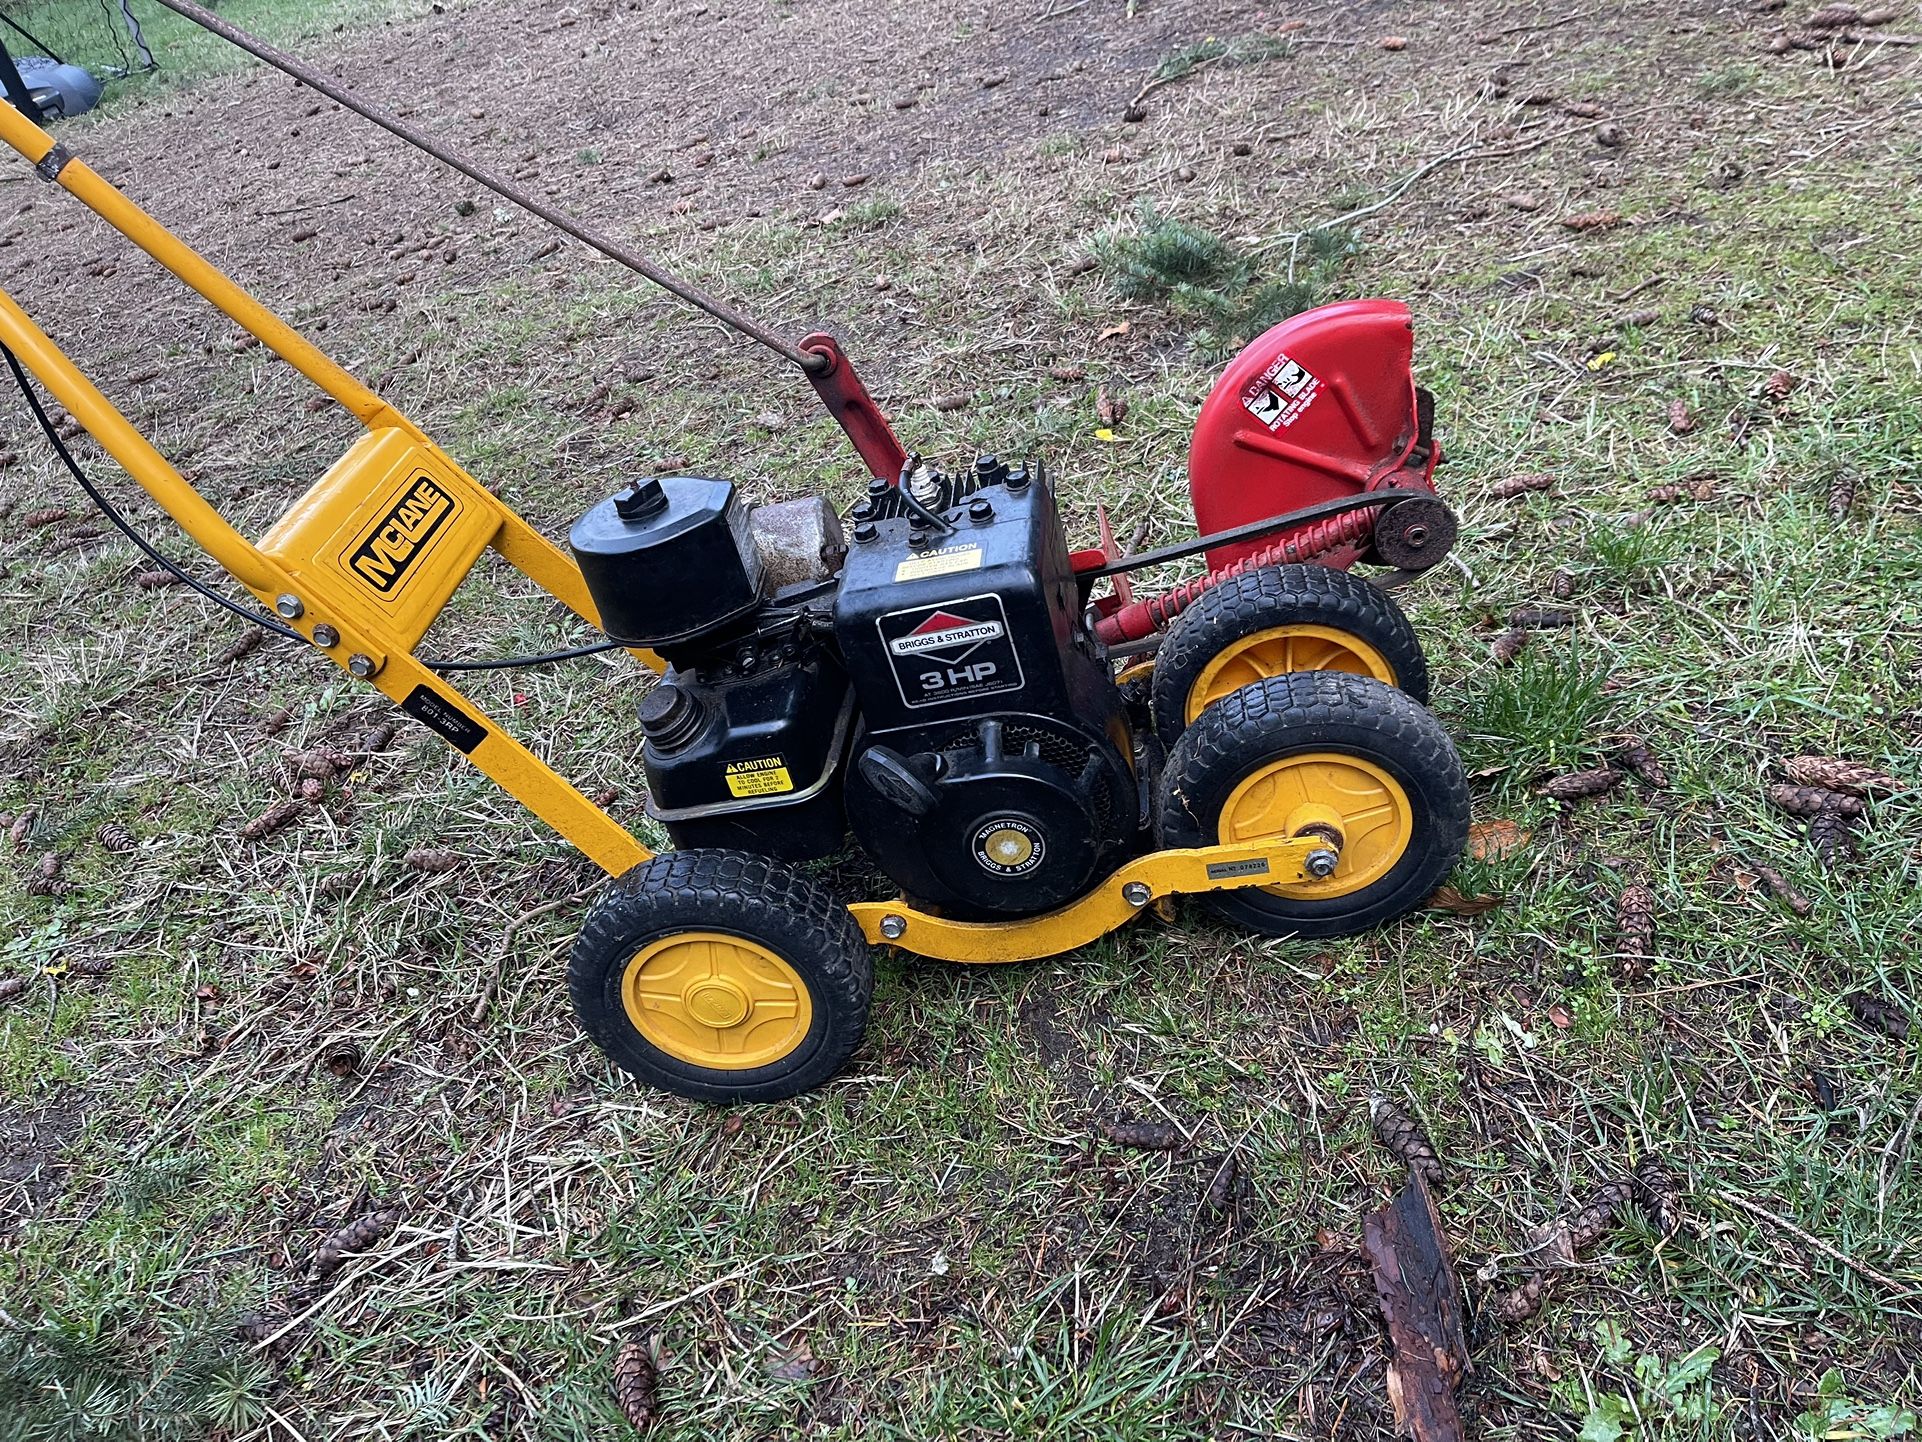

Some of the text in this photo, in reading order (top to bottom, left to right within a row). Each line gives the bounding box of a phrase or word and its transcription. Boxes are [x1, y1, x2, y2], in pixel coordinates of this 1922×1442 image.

[1249, 353, 1290, 396] DANGER
[1269, 378, 1320, 432] ROTATING BLADE
[1282, 392, 1317, 427] Stop engine
[920, 543, 977, 558] CAUTION
[898, 625, 996, 650] BRIGGS & STRATTON
[920, 661, 997, 690] 3 HP
[736, 757, 782, 772] CAUTION
[736, 783, 763, 791] MINUTES
[977, 850, 1002, 870] BRIGGS
[1015, 842, 1041, 871] STRATTON
